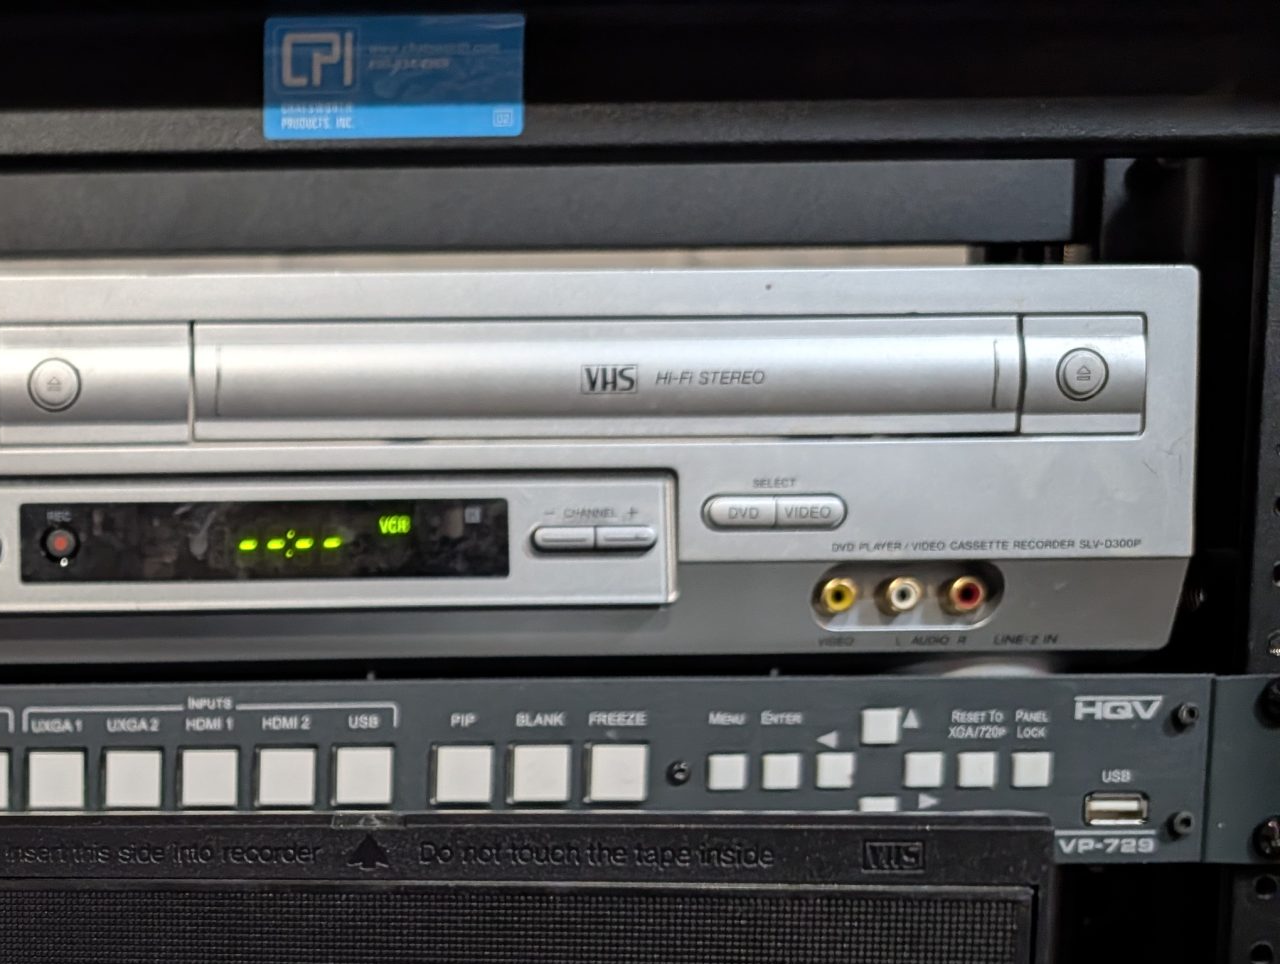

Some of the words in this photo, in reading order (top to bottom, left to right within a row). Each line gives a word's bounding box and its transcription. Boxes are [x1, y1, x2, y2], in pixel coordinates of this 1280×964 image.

[282, 32, 353, 87] CPI
[583, 366, 636, 392] VHS
[698, 370, 765, 386] STEREO
[753, 478, 797, 488] SELECT
[563, 508, 615, 519] CHANNEL
[728, 506, 760, 520] DVD
[784, 505, 832, 519] VIDEO
[831, 543, 855, 552] DVD
[860, 542, 902, 552] PLAYER
[911, 540, 946, 551] VIDEO
[950, 539, 1008, 550] CASSETTE
[1013, 539, 1075, 550] RECORDER
[911, 636, 950, 645] AUDIO
[1043, 635, 1060, 645] IN
[188, 697, 233, 710] INPUTS
[1074, 697, 1163, 720] HQV
[31, 719, 73, 733] UXGA
[106, 719, 147, 732] UXGA
[149, 718, 160, 732] 2
[186, 717, 224, 731] HDMI
[262, 716, 299, 730] HDMI
[300, 716, 311, 730] 2
[348, 715, 379, 729] USB
[451, 713, 477, 727] PIP
[516, 712, 564, 727] BLANK
[589, 712, 648, 726] FREEZE
[1102, 769, 1132, 783] USB
[1058, 838, 1155, 853] VP-729
[72, 843, 110, 864] this
[118, 843, 164, 864] side
[173, 843, 211, 864] into
[221, 843, 320, 864] recorder
[420, 842, 451, 864] Do
[461, 843, 500, 864] not
[511, 843, 580, 865] touch
[587, 843, 626, 866] the
[635, 845, 691, 869] tape
[698, 844, 774, 868] inside
